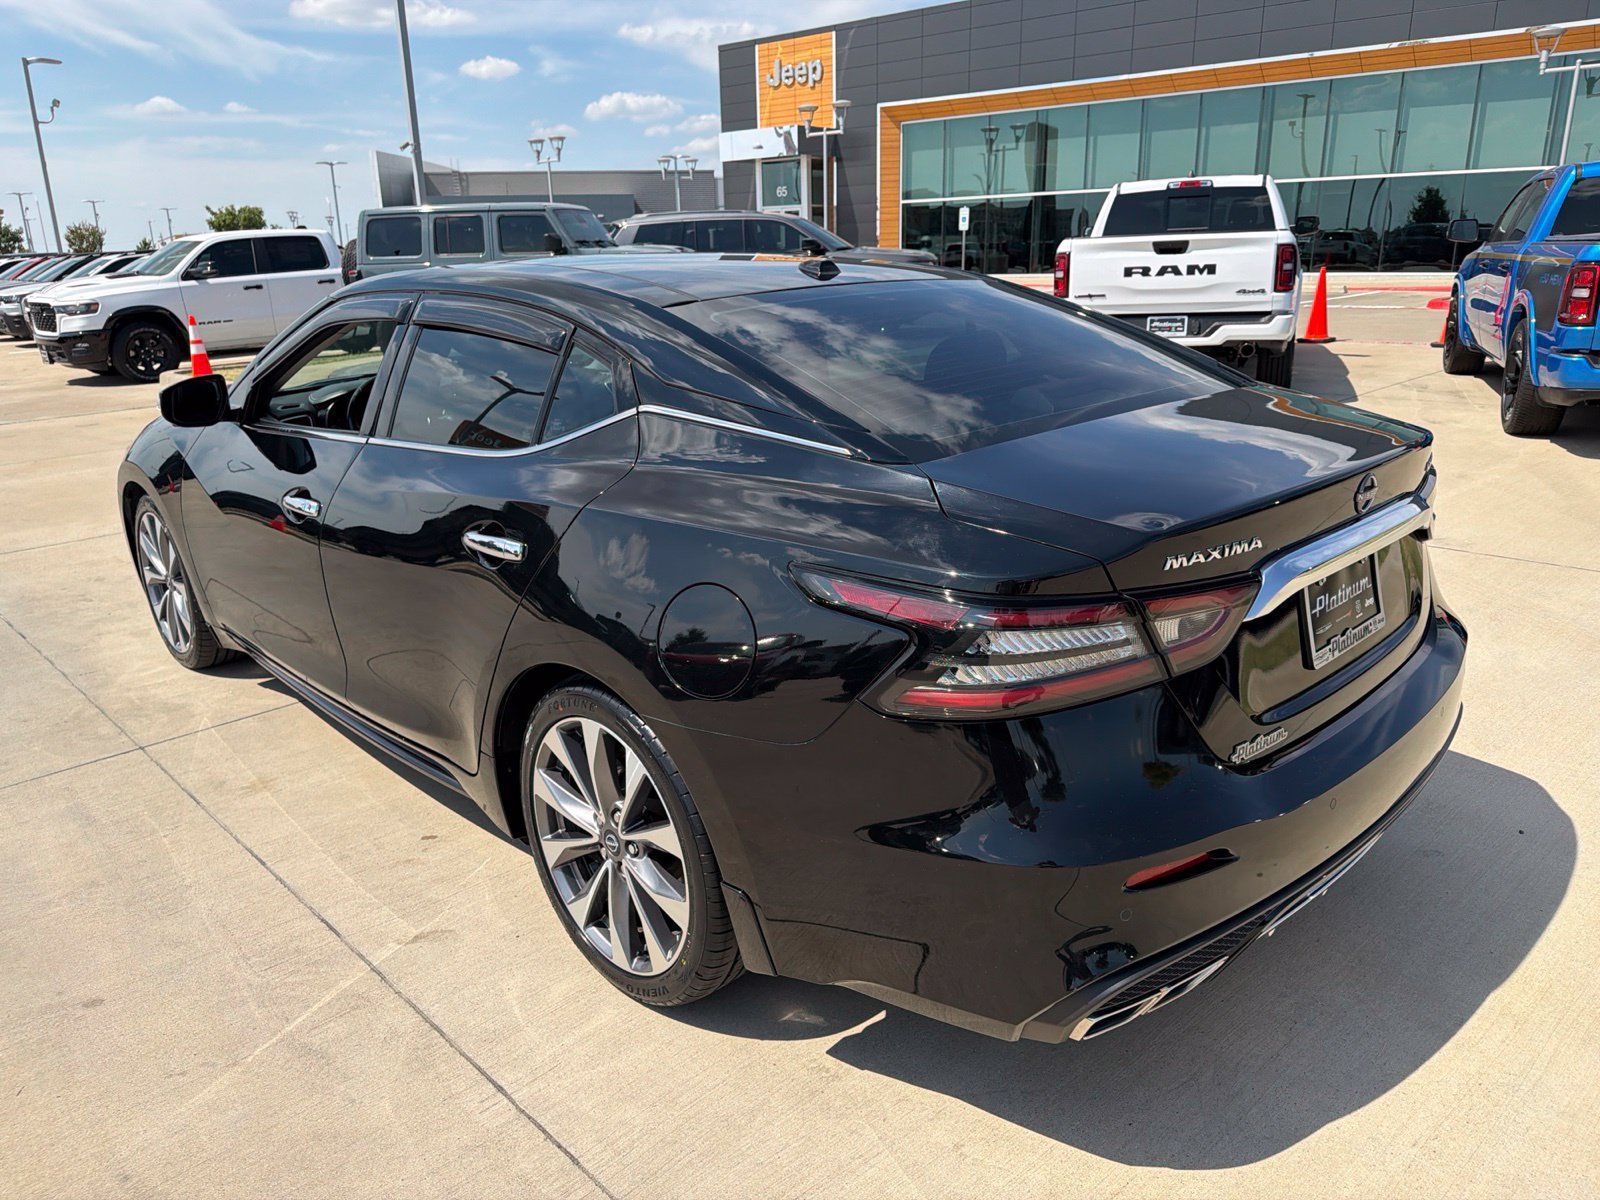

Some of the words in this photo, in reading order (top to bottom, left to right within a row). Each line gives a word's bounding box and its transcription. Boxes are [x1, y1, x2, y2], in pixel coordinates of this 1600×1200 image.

[766, 57, 822, 88] Jeep
[776, 185, 788, 198] 65
[1123, 263, 1217, 278] RAM
[1163, 536, 1263, 571] MAXIMA
[1312, 577, 1373, 618] Platinum
[1329, 624, 1373, 658] Platinum
[547, 697, 597, 715] FORTUNE
[1231, 727, 1289, 764] Platinum
[625, 984, 670, 999] VIENTO
